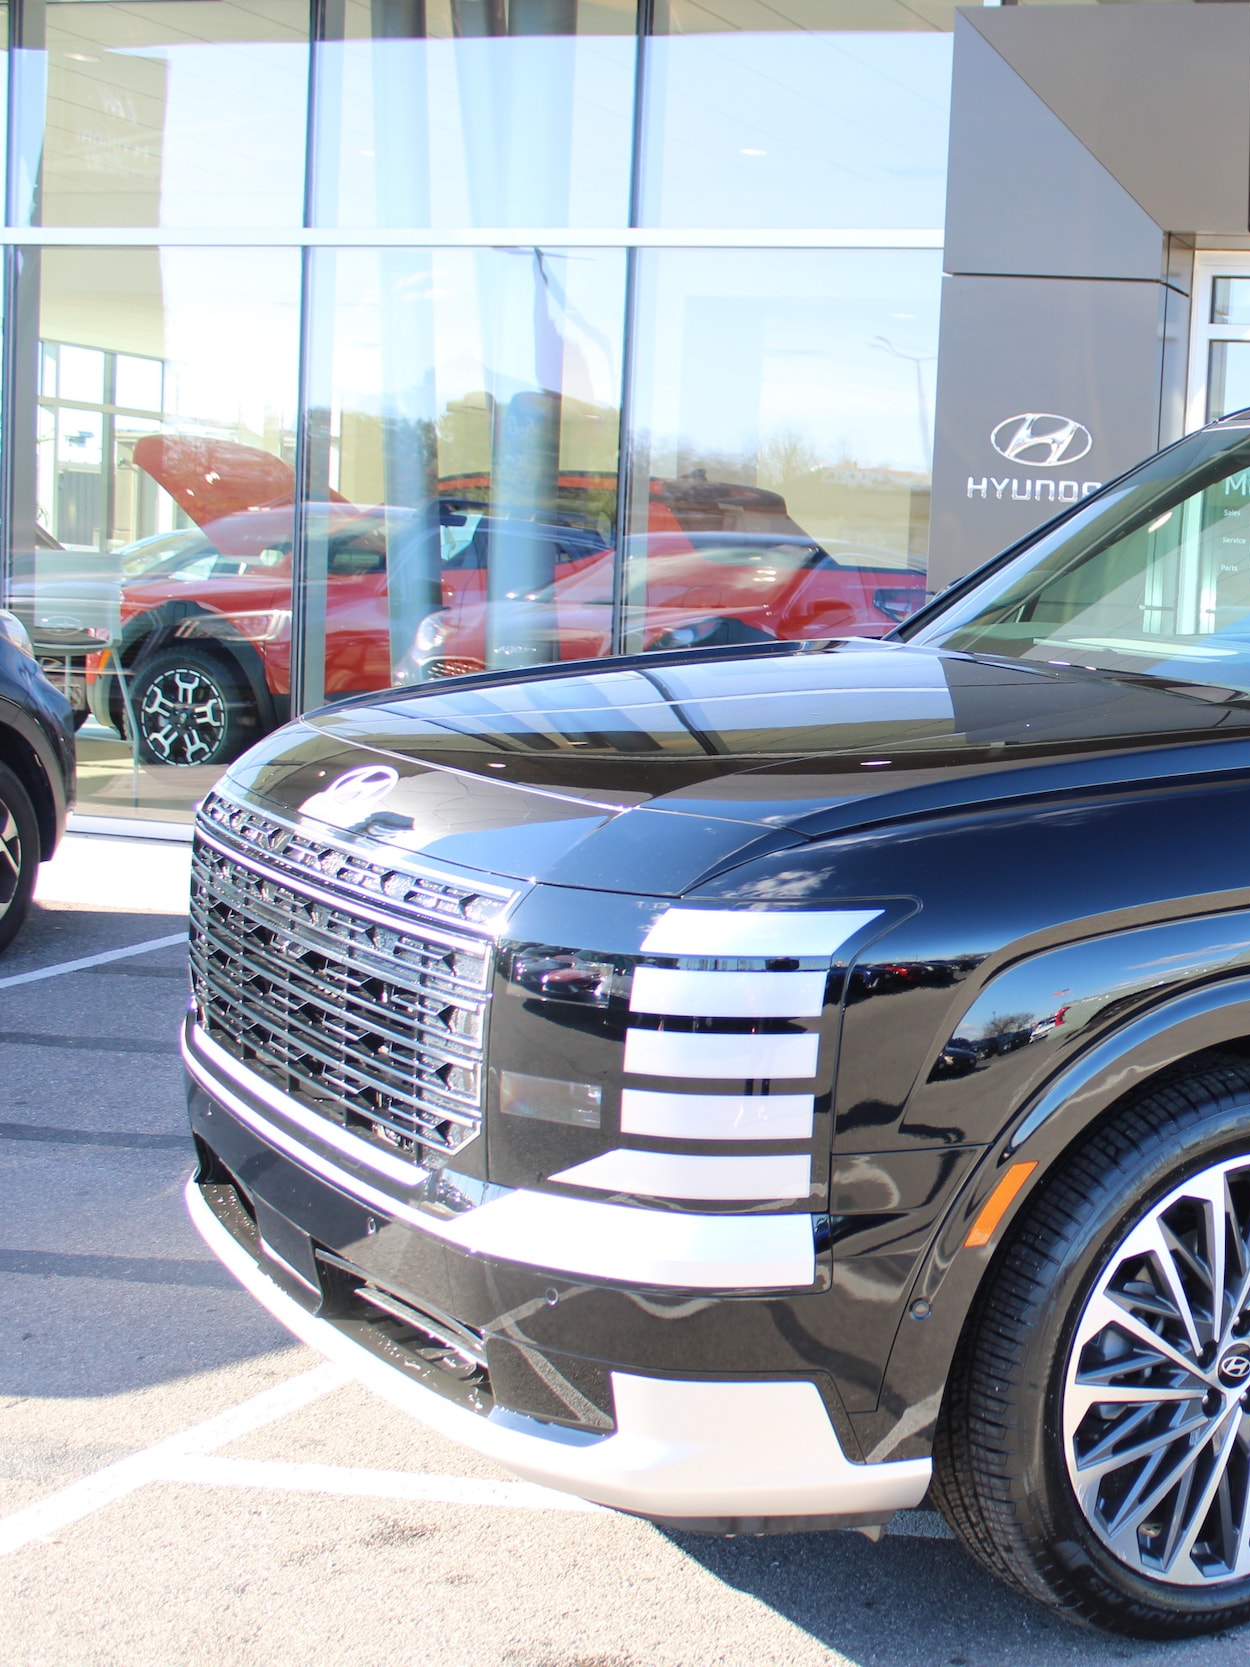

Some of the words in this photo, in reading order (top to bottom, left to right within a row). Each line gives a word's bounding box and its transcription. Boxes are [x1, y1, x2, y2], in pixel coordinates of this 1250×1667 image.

[967, 476, 1103, 503] HYUNDA
[1223, 509, 1240, 517] Sales
[1222, 536, 1246, 544] Service
[1220, 564, 1237, 572] Parts
